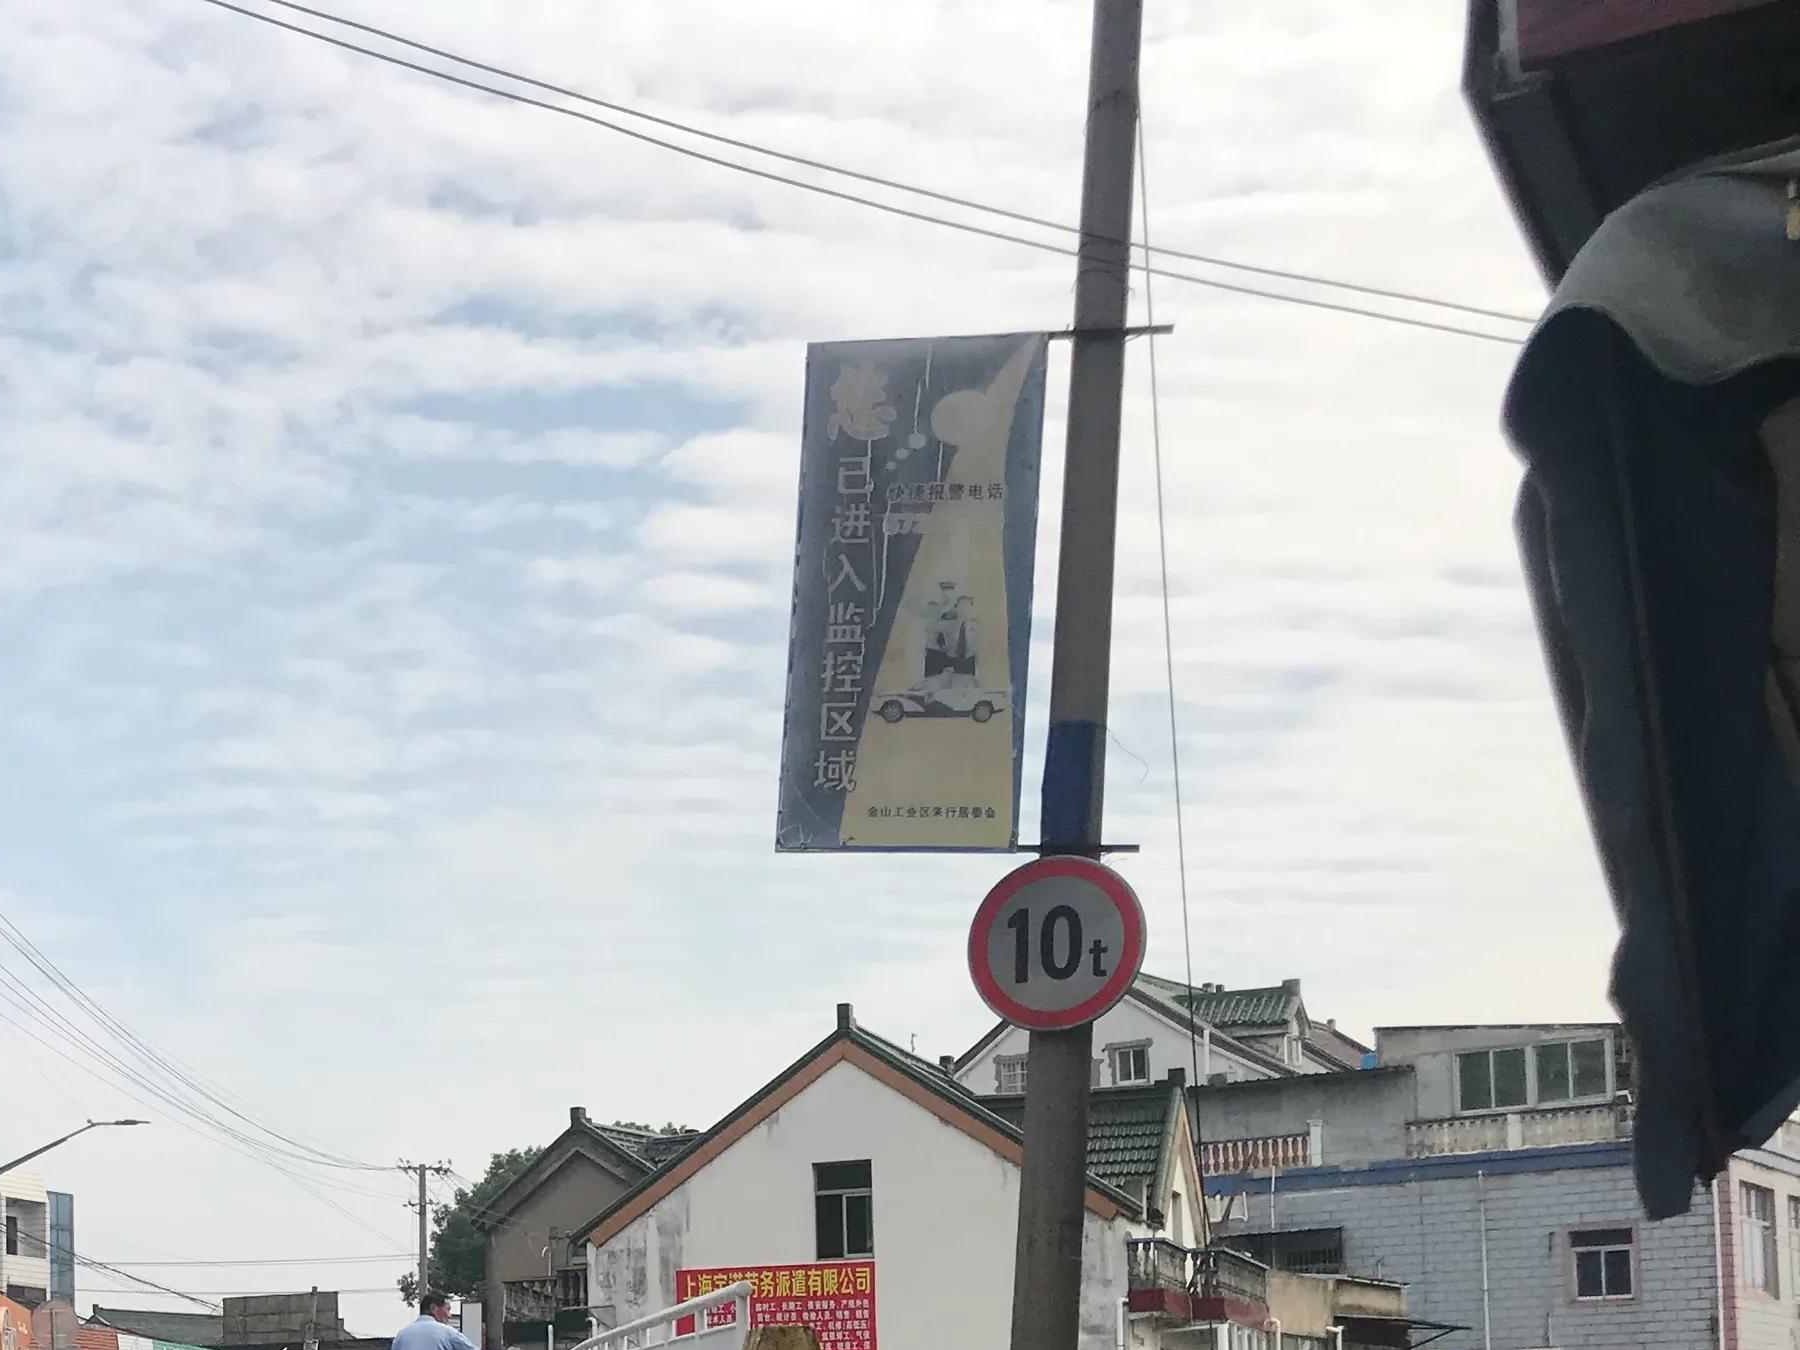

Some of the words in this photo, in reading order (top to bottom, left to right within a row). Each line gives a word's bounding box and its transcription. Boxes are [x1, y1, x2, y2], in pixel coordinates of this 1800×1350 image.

[813, 456, 872, 791] 已进入监控区域
